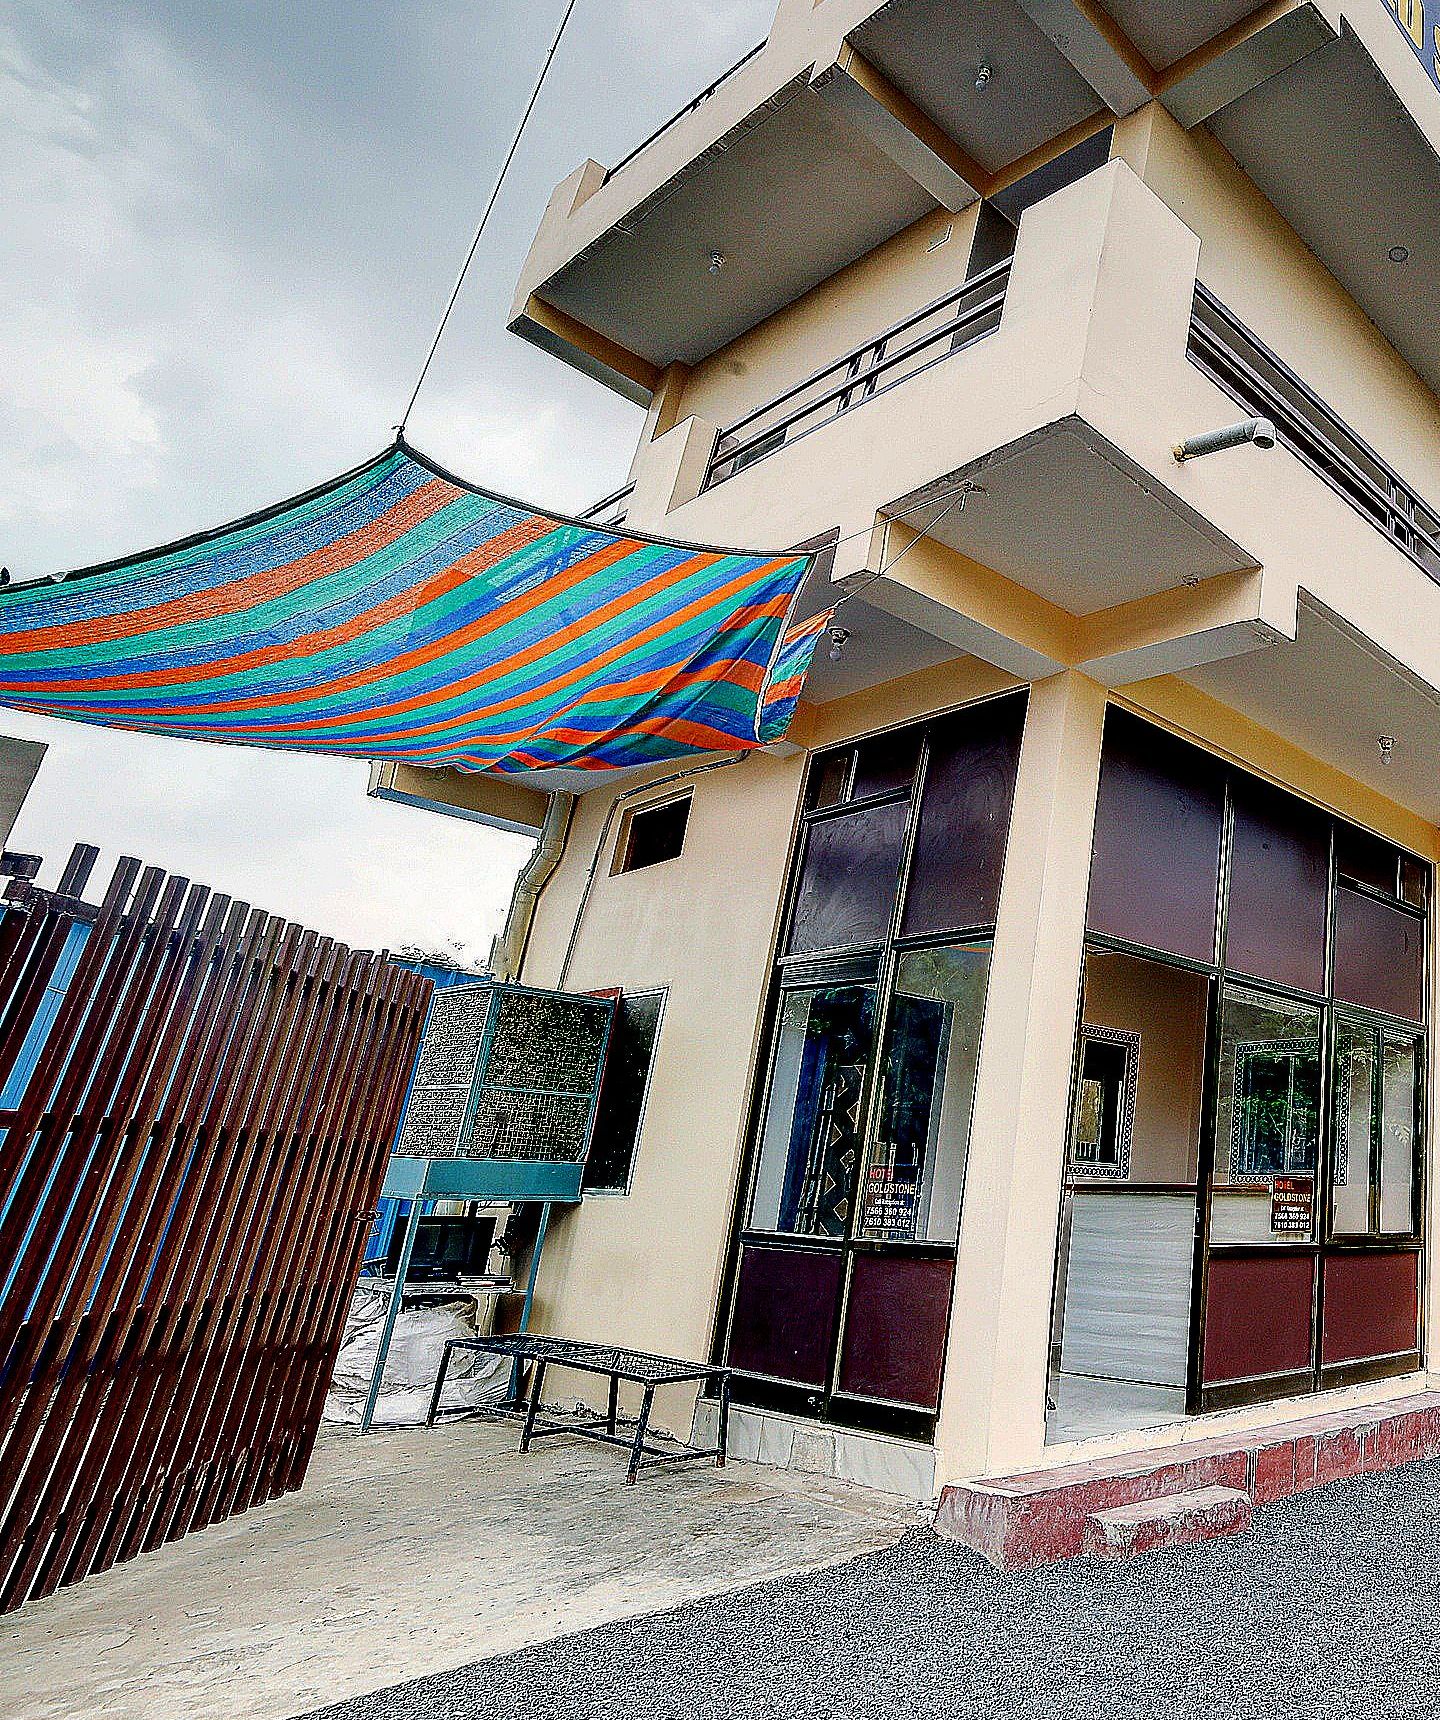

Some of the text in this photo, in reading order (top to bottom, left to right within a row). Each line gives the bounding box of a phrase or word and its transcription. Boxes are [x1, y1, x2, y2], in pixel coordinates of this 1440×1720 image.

[868, 1182, 916, 1195] GOLDSTONE
[1274, 1180, 1295, 1190] HOTEL
[1273, 1192, 1311, 1203] GOLDSTONE
[866, 1206, 912, 1217] 7566 360 924
[864, 1217, 882, 1227] 7610
[896, 1218, 911, 1228] 012
[1299, 1221, 1310, 1229] 012
